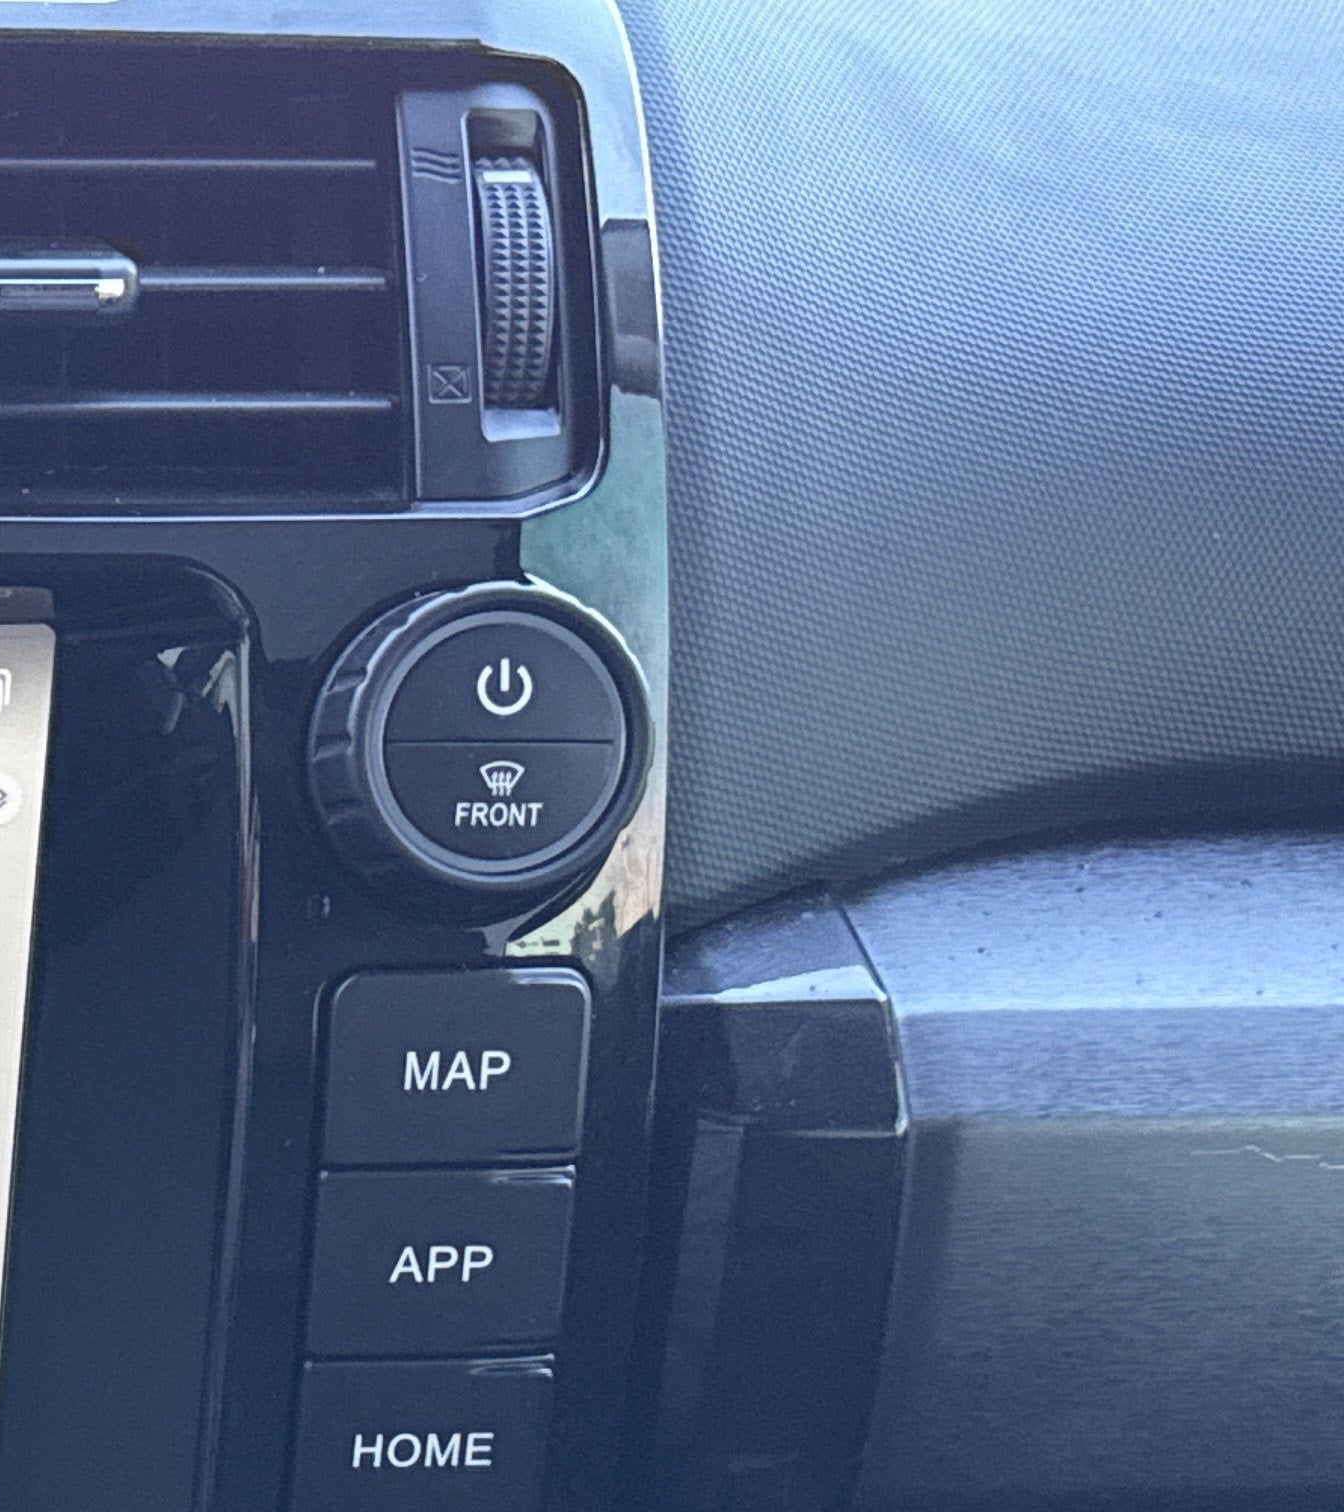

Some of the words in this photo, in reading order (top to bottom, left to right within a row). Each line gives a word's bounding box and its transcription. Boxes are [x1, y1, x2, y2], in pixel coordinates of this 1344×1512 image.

[454, 802, 544, 827] FRONT
[403, 1050, 511, 1091] MAP
[389, 1245, 494, 1283] APP
[351, 1432, 494, 1468] HOME
